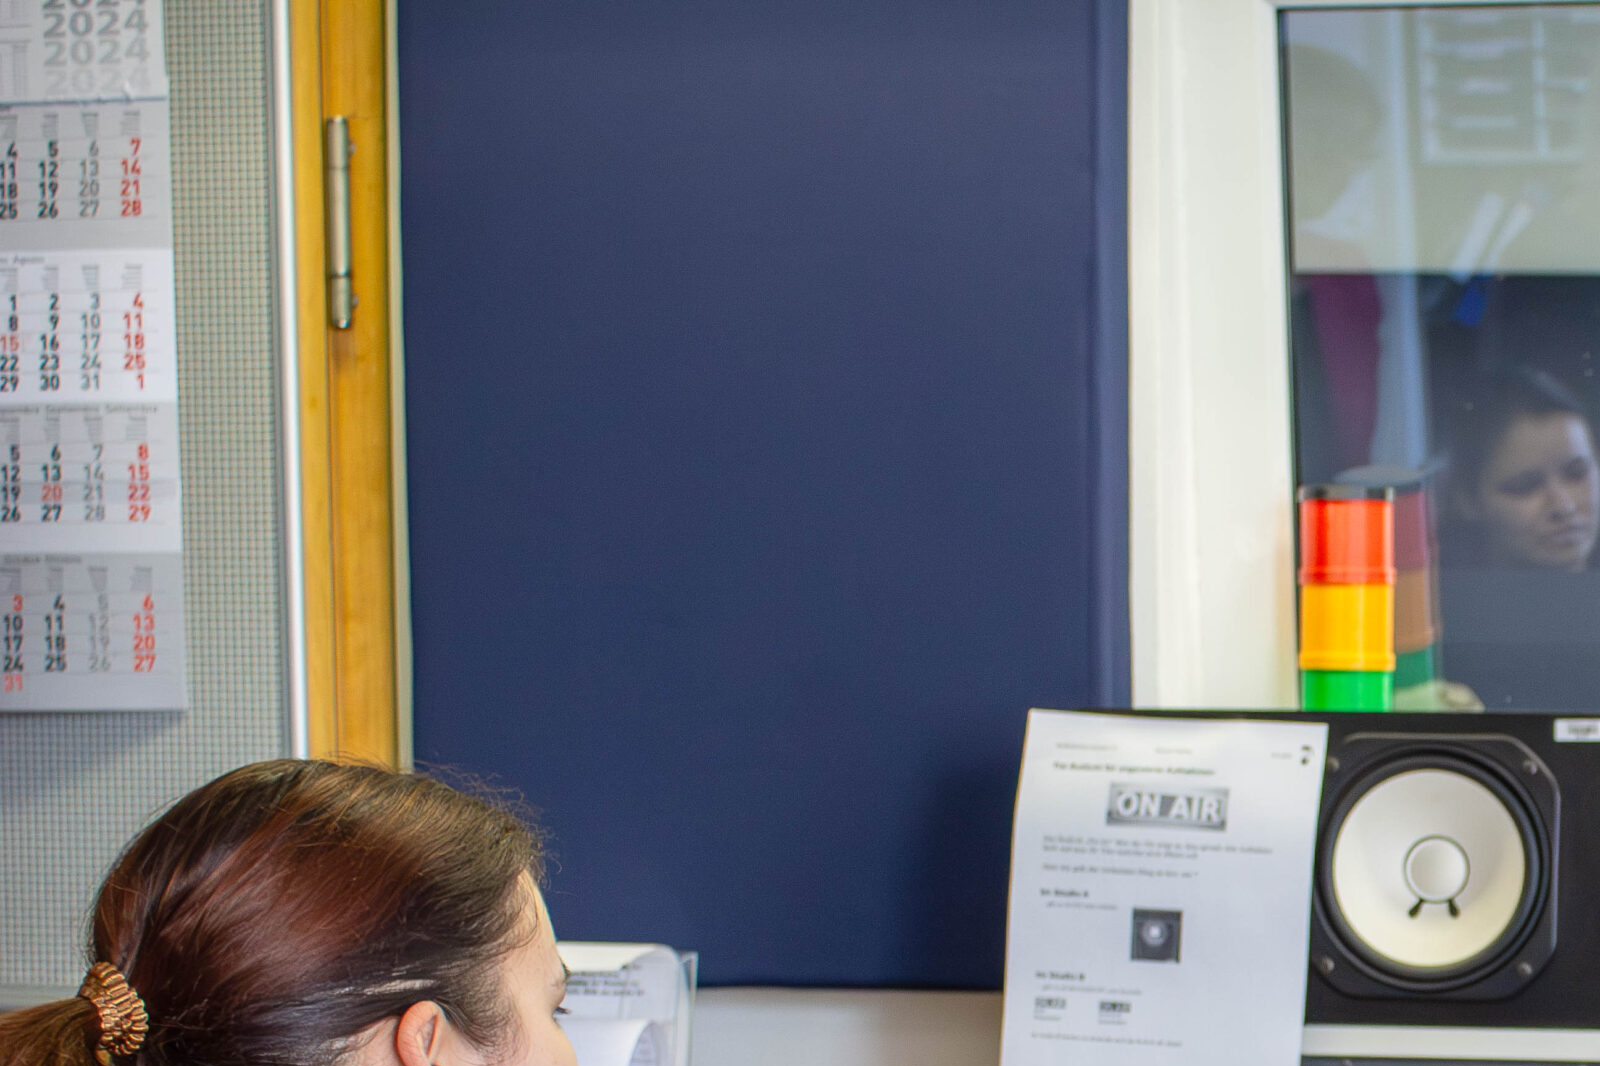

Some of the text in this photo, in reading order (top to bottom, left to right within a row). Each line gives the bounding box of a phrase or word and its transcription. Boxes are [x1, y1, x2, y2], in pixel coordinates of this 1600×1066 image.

[43, 9, 149, 39] 2024
[43, 36, 150, 67] 2024
[7, 137, 142, 159] 4 5 6 7
[38, 160, 59, 178] 12
[79, 159, 99, 177] 13
[121, 158, 141, 176] 14
[38, 181, 59, 199] 19
[79, 180, 99, 197] 20
[120, 179, 140, 197] 21
[38, 200, 59, 219] 26
[79, 200, 100, 218] 27
[120, 199, 142, 217] 28
[10, 291, 144, 311] 1 2 3 4
[8, 312, 143, 332] 8 9 10 11
[40, 333, 60, 351] 16
[80, 333, 101, 350] 17
[124, 332, 144, 350] 18
[0, 352, 146, 372] 22 23 24 25
[0, 373, 144, 392] 29 30 31 1
[9, 442, 149, 462] 5 6 7 8
[1, 463, 150, 482] 12 13 14 15
[1, 483, 150, 502] 19 20 21 22
[1, 504, 151, 522] 26 27 28 29
[12, 593, 23, 612] 3
[53, 593, 65, 611] 4
[143, 592, 154, 611] 6
[3, 613, 23, 632] 10
[45, 613, 64, 631] 11
[133, 612, 155, 631] 13
[3, 634, 23, 652] 17
[45, 634, 66, 652] 18
[133, 633, 155, 651] 20
[3, 653, 156, 672] 24 25 26 27
[3, 673, 23, 693] 31
[1116, 791, 1222, 824] ON AIR
